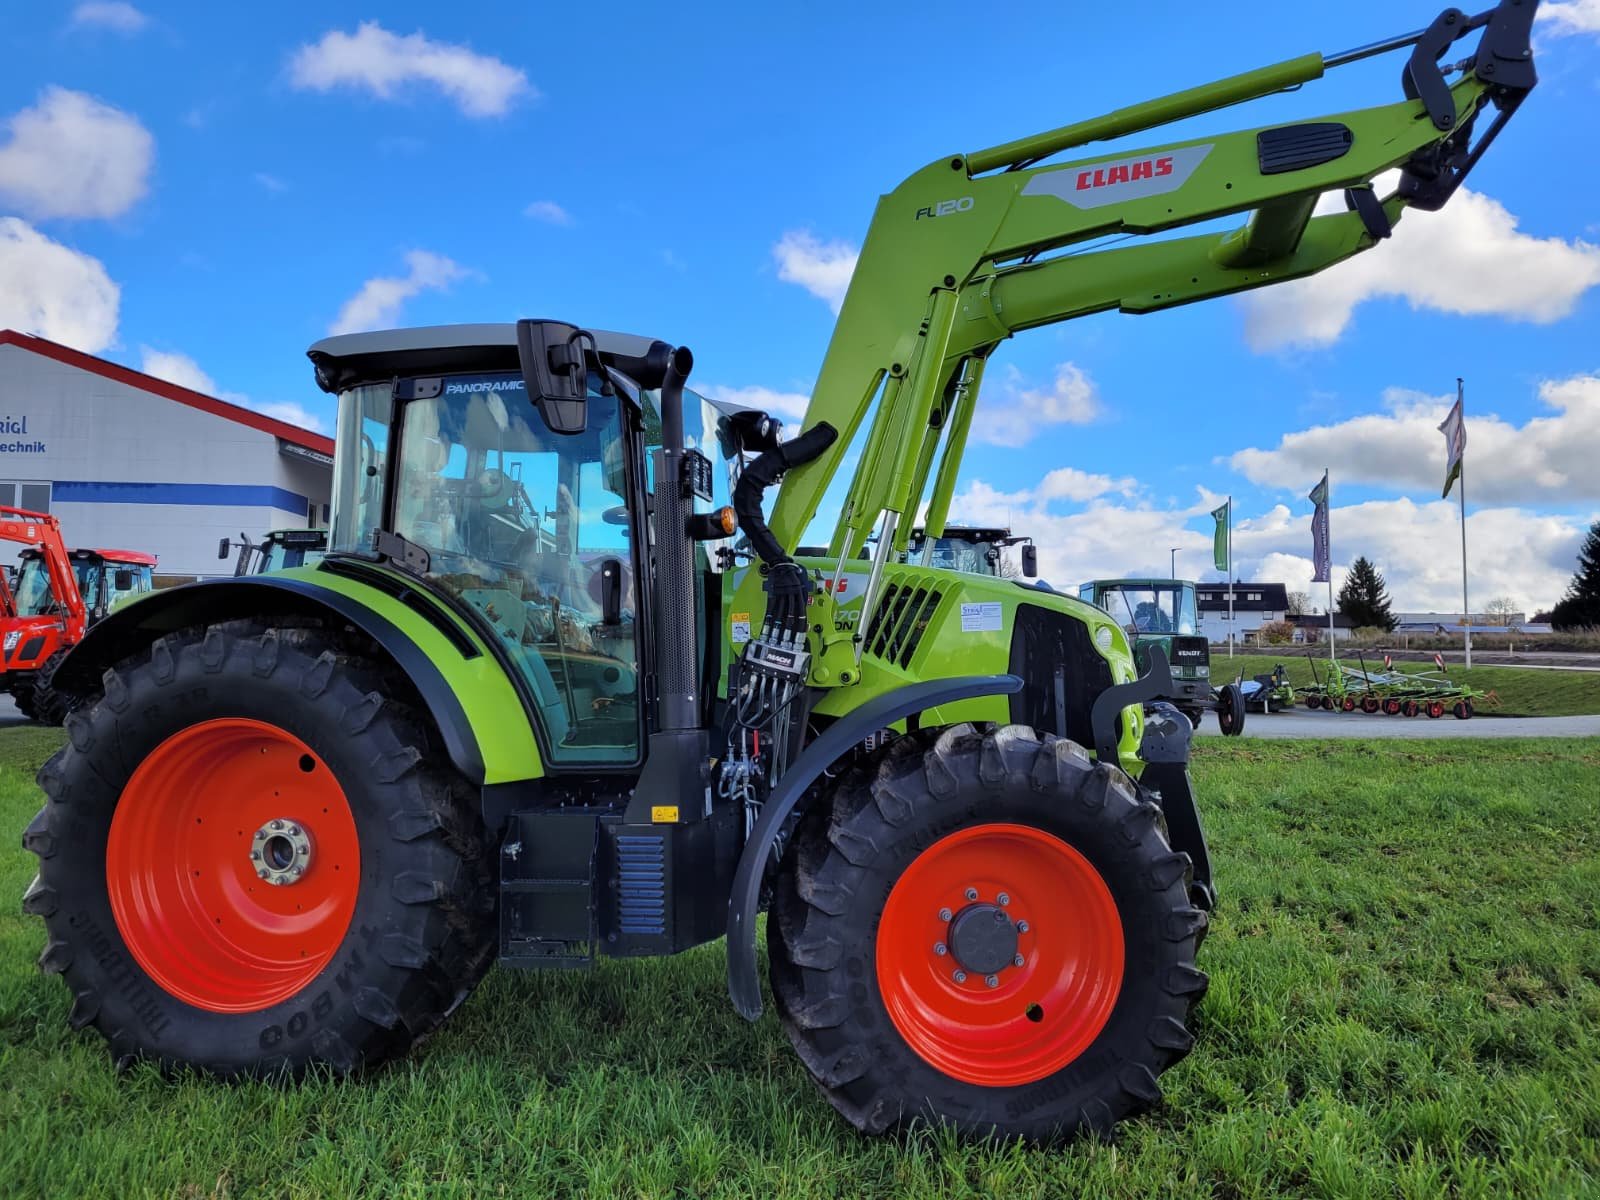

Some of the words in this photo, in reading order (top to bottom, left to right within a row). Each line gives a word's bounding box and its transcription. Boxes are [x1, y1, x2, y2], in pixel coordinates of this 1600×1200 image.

[1075, 157, 1173, 191] CLAAS
[915, 196, 975, 220] FL120
[446, 380, 526, 395] PANORAMIC
